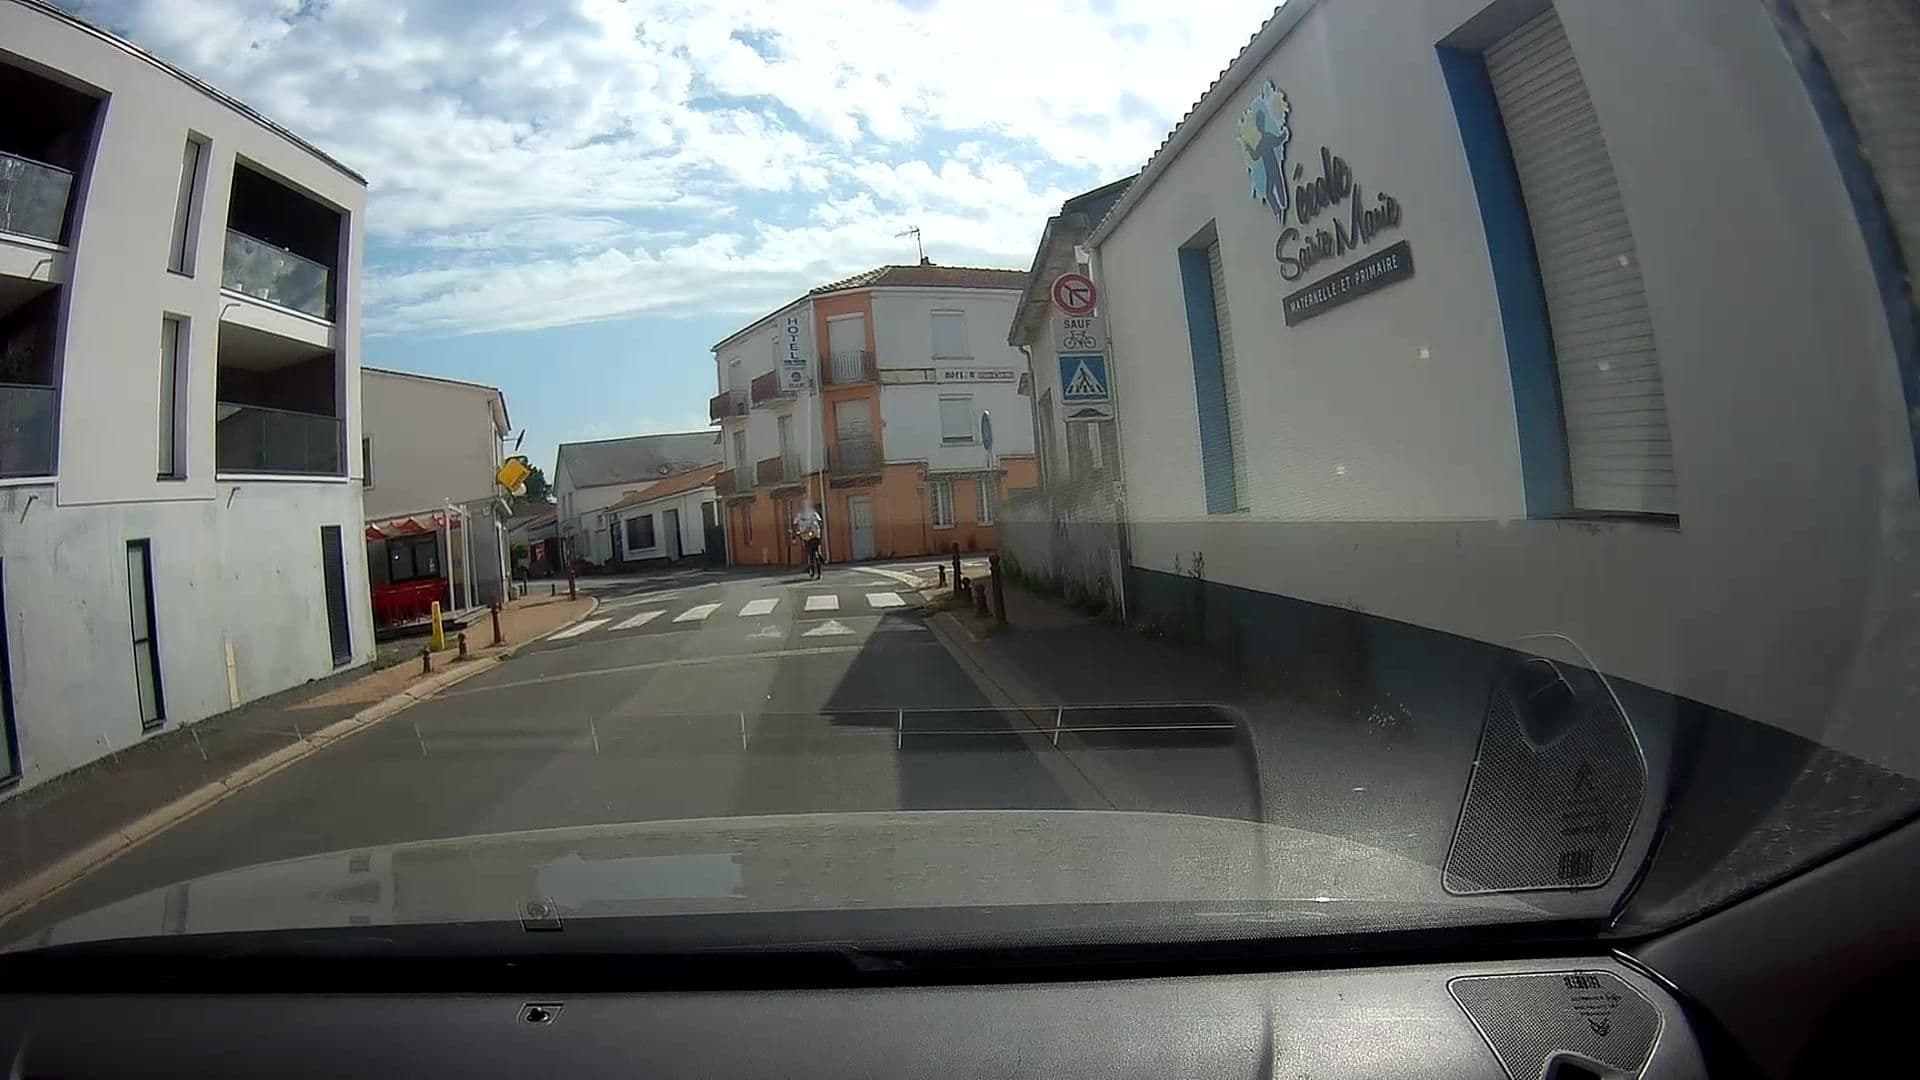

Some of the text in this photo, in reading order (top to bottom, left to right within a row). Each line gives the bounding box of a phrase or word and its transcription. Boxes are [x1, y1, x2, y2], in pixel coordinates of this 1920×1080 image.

[1276, 183, 1401, 280] Sainte Marie
[1290, 254, 1399, 312] MATERNELLE ET PRIMAIRE
[787, 317, 800, 359] HOTEL
[1063, 319, 1092, 330] SAUF
